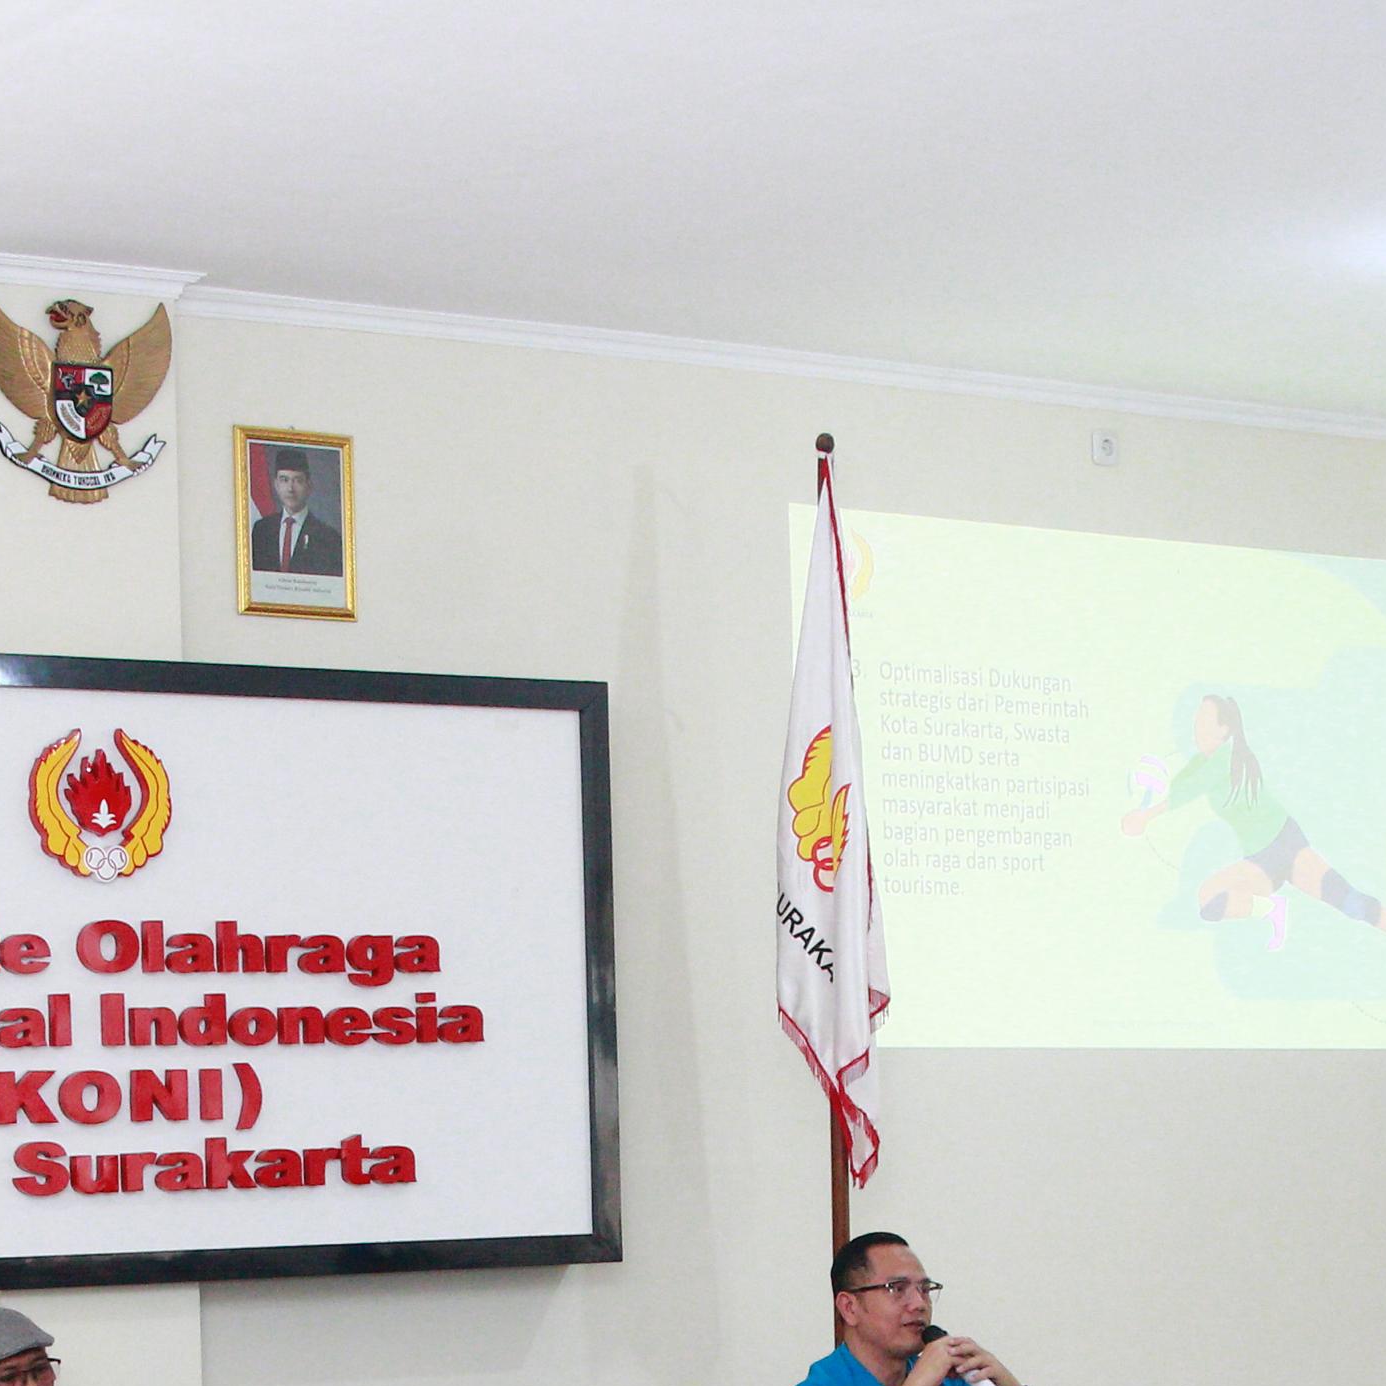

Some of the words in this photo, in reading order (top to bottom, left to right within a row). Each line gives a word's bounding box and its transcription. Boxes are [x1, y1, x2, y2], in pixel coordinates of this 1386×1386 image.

[879, 660, 984, 687] Optimalisasi
[989, 668, 1072, 694] Dukungan
[879, 689, 951, 713] strategis
[956, 693, 989, 713] dari
[994, 695, 1090, 719] Pemerintah
[880, 714, 918, 735] Kota
[924, 717, 1009, 743] Surakarta,
[1014, 722, 1070, 744] Swasta
[881, 740, 912, 761] dan
[918, 743, 973, 765] BUMD
[979, 749, 1020, 767] serta
[881, 770, 1000, 793] meningkatkan
[1006, 776, 1090, 798] partisipasi
[882, 796, 978, 817] masyarakat
[983, 801, 1050, 823] menjadi
[883, 820, 939, 845] bagian
[945, 826, 1073, 849] pengembangan
[883, 848, 919, 868] olah
[925, 854, 961, 872] raga
[966, 850, 997, 870] dan
[1002, 855, 1045, 875] sport
[884, 875, 965, 896] tourisme.
[76, 919, 441, 988] Olahraga
[100, 992, 485, 1047] Indonesia
[13, 1134, 417, 1197] Surakarta
